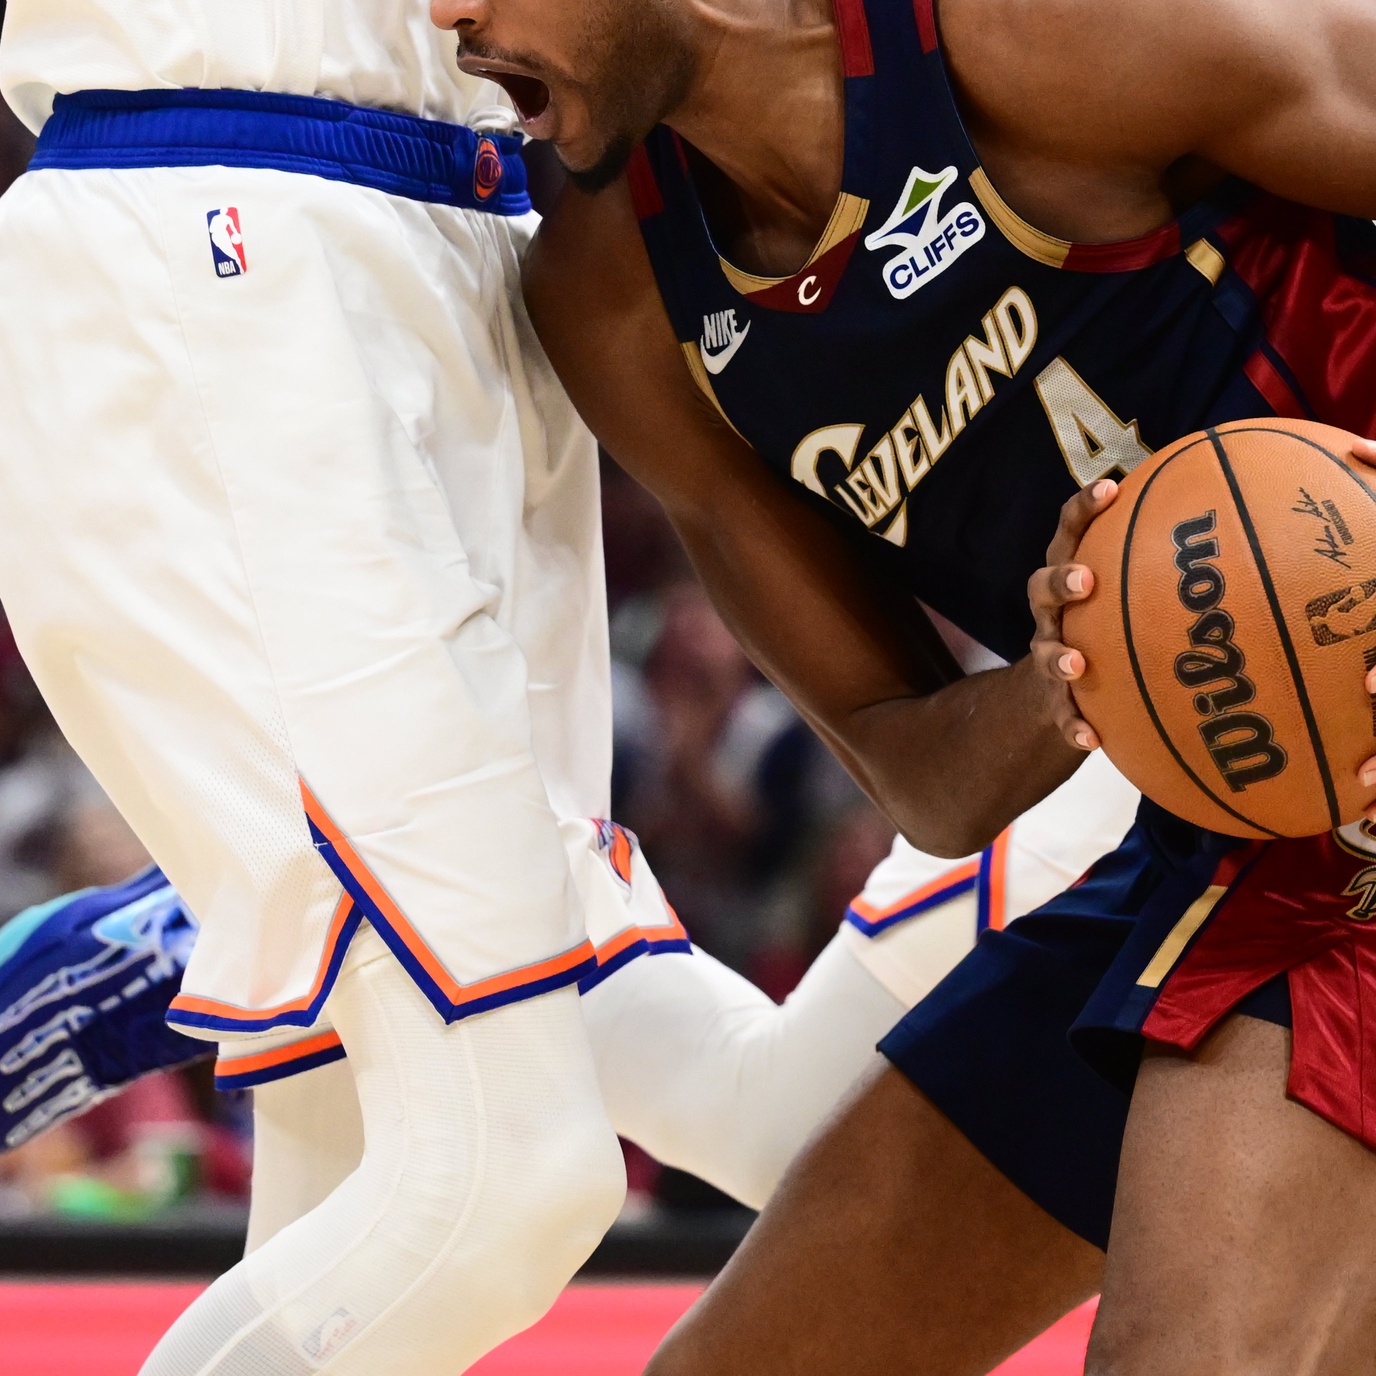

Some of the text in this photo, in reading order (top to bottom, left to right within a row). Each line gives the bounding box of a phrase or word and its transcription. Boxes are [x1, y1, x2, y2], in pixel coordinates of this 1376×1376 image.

[217, 259, 237, 277] NBA
[889, 209, 981, 292] CLIFFS
[797, 275, 822, 306] C
[703, 308, 741, 350] NIKE
[1033, 354, 1157, 492] 4
[1170, 508, 1289, 793] Wilson
